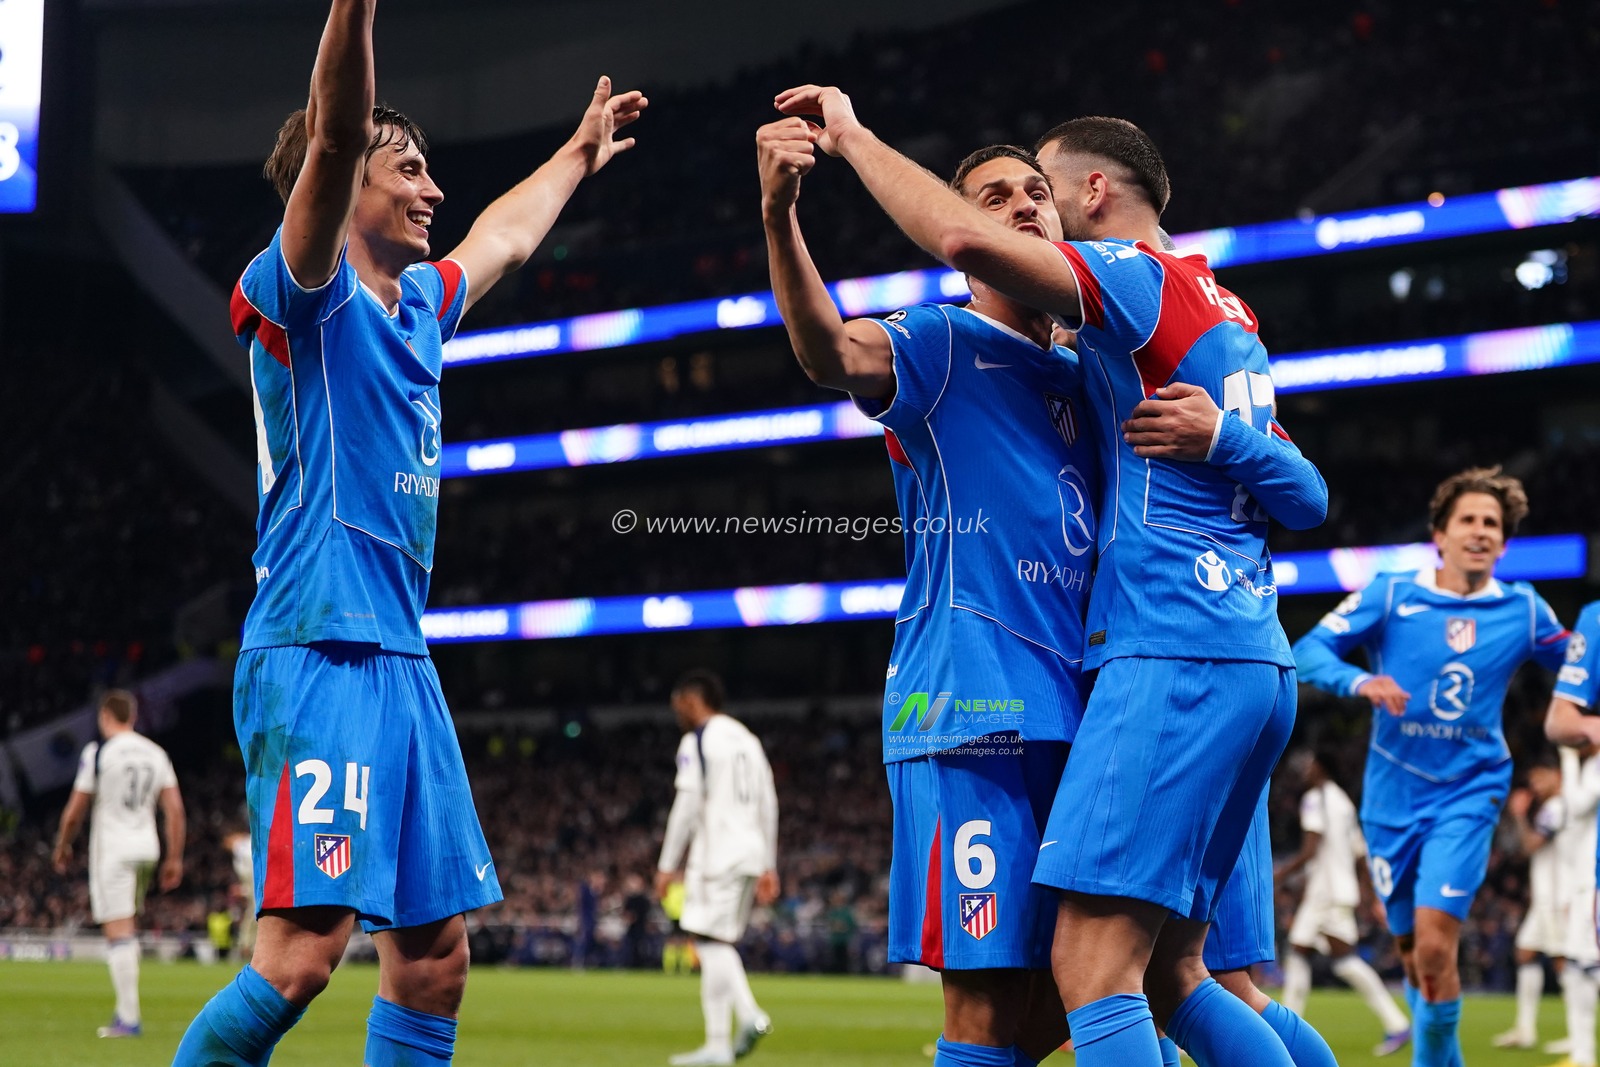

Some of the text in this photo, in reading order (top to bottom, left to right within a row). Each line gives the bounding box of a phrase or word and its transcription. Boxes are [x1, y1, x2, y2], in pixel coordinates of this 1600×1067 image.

[394, 472, 440, 498] RIYADH
[1017, 559, 1085, 592] RIYADH
[295, 759, 370, 831] 24
[953, 819, 997, 890] 6
